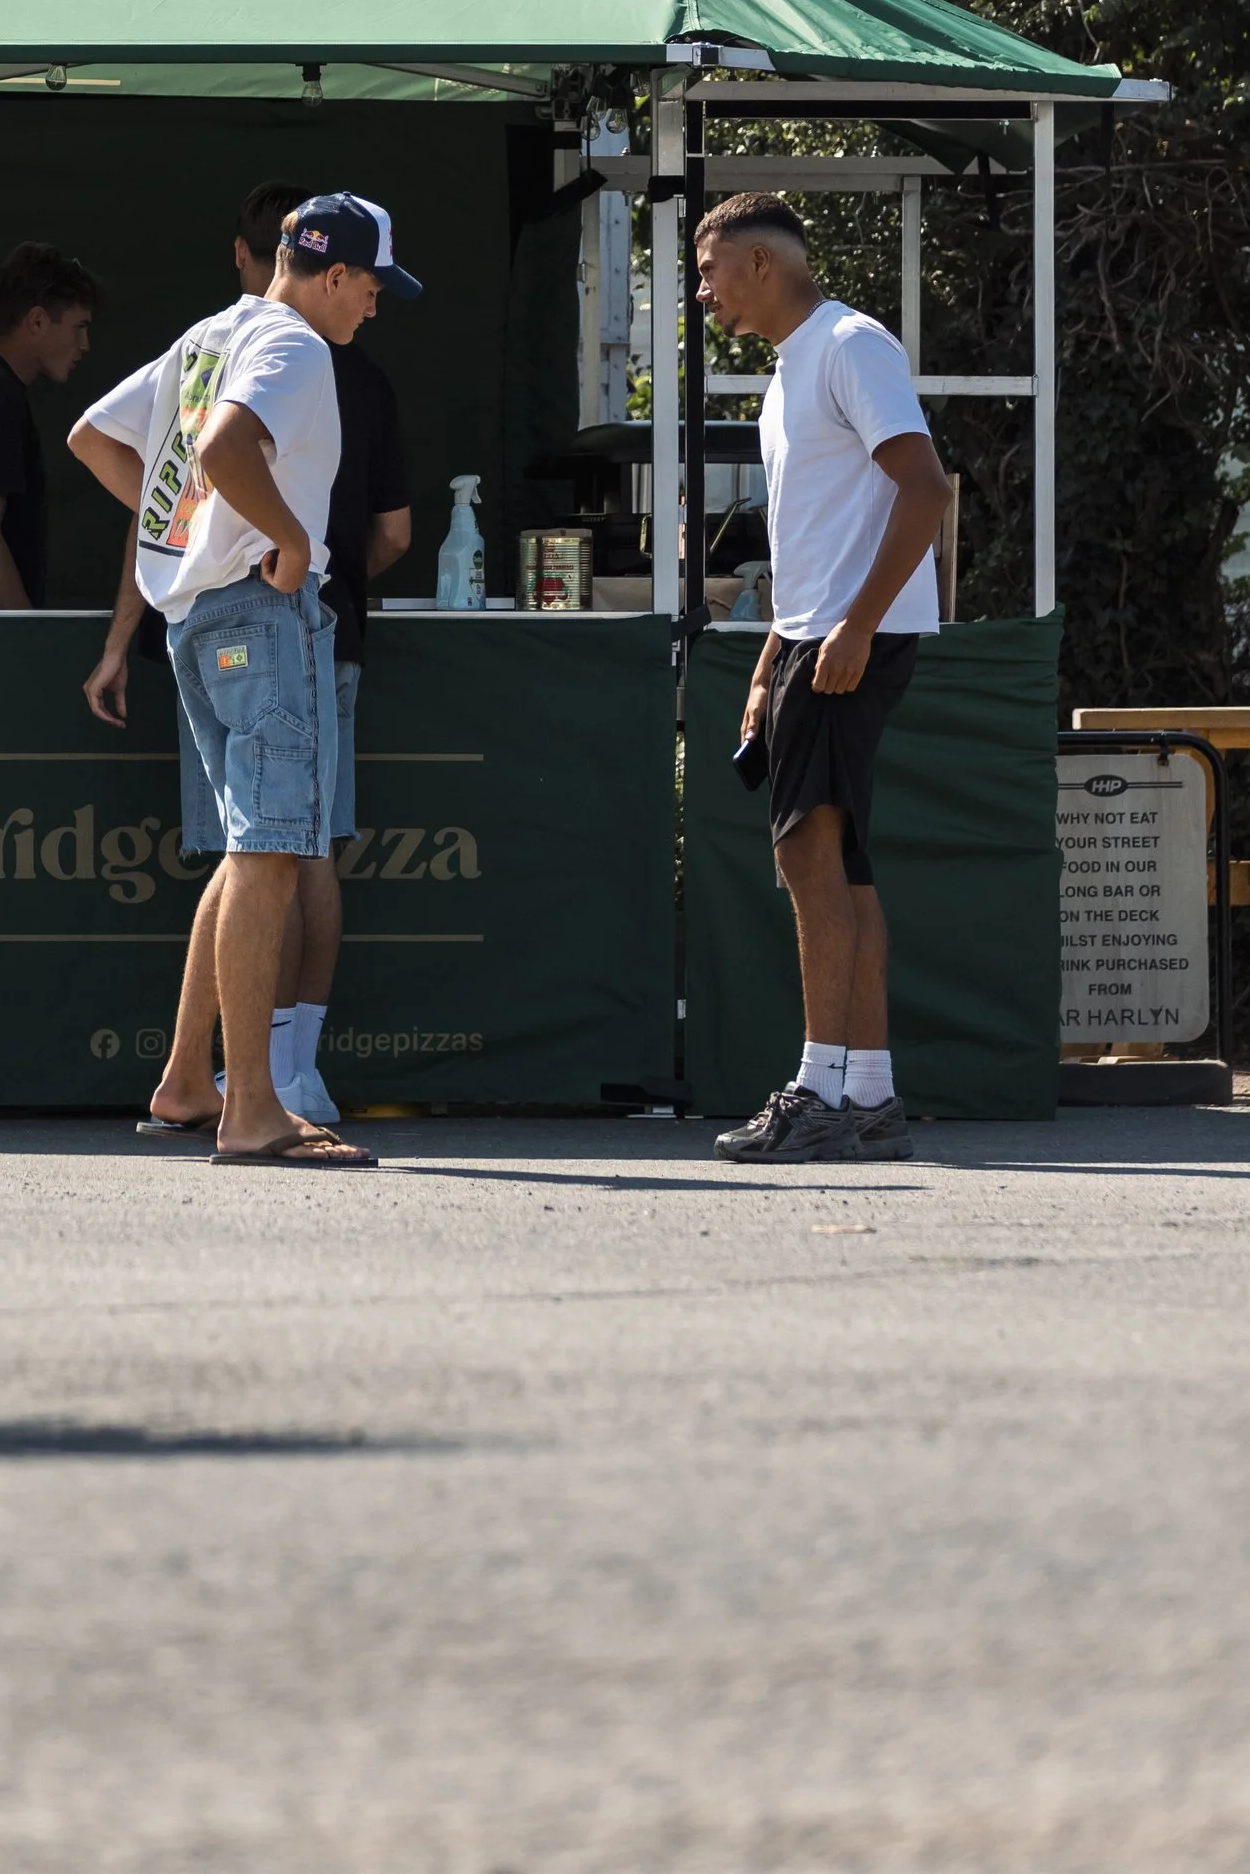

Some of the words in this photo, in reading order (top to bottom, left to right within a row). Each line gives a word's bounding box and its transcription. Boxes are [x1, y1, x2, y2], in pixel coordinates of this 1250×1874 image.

[1056, 812, 1090, 824] WHY
[1094, 812, 1126, 824] NOT
[1129, 811, 1158, 824] EAT
[1055, 836, 1097, 849] YOUR
[1102, 836, 1160, 848] STREET
[336, 826, 482, 881] zza
[1106, 861, 1120, 873] IN
[1125, 860, 1157, 873] OUR
[1103, 885, 1134, 897] BAR
[1139, 885, 1161, 897] OR
[1058, 910, 1080, 922] ON
[1084, 910, 1114, 922] THE
[1118, 909, 1160, 922] DECK
[1102, 933, 1178, 947] ENJOYING
[1058, 959, 1091, 971] RINK
[1095, 957, 1189, 971] PURCHASED
[1088, 983, 1132, 995] FROM
[1088, 1006, 1179, 1027] HARLYN
